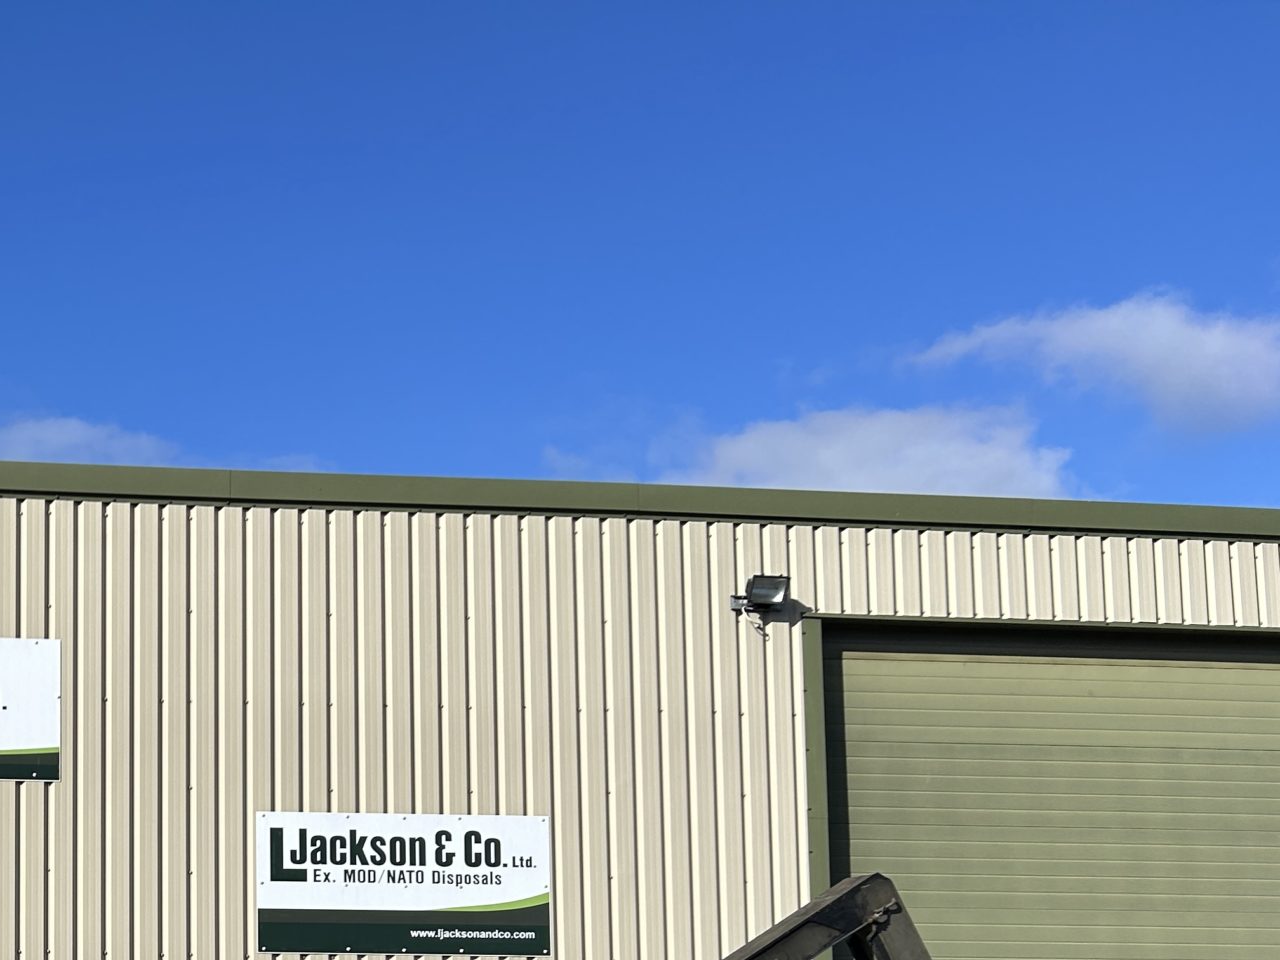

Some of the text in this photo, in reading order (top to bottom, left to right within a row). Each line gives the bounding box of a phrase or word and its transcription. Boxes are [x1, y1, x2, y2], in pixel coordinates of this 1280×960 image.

[434, 829, 456, 868] &
[463, 830, 508, 868] Co.
[512, 856, 537, 869] Ltd.
[313, 868, 503, 887] Ex. MOD/NATO Disposals
[410, 928, 536, 940] www.ljacksonandco.com
